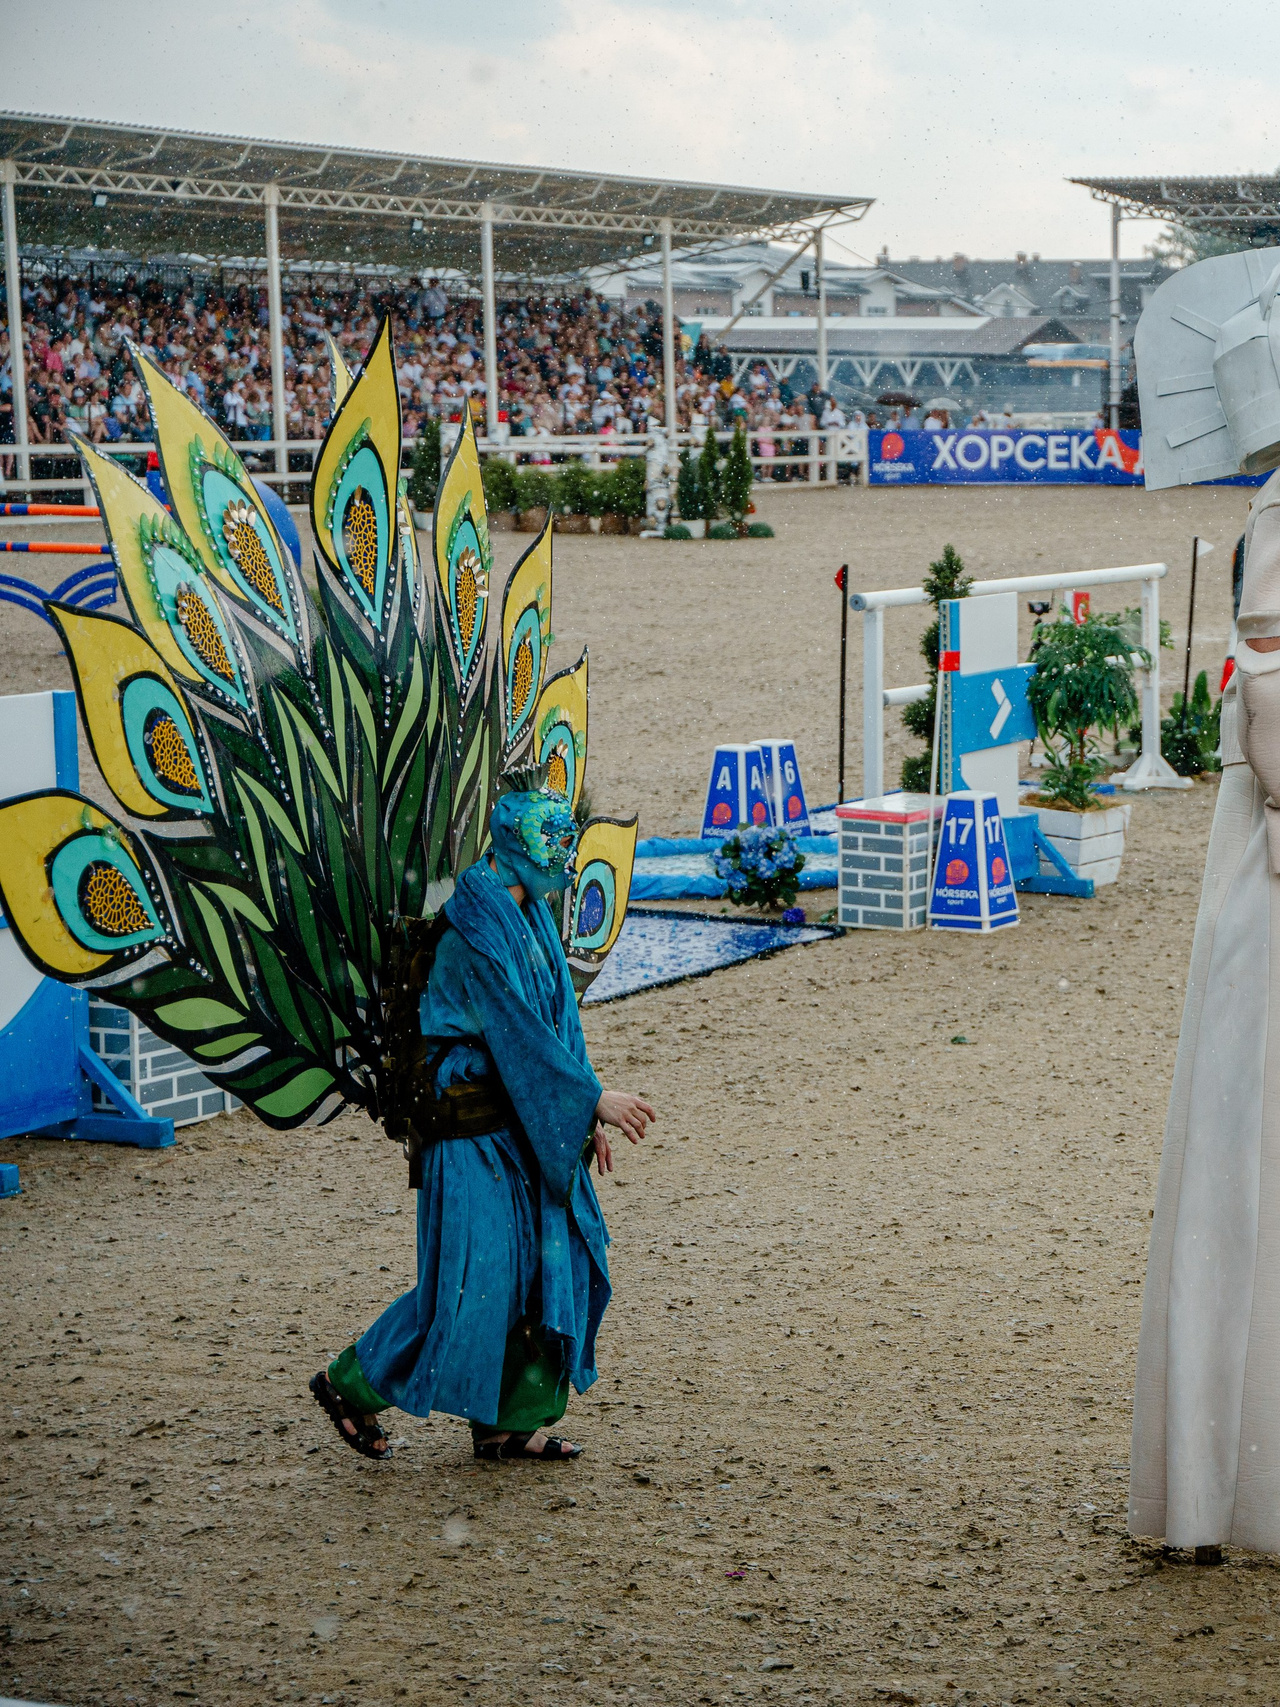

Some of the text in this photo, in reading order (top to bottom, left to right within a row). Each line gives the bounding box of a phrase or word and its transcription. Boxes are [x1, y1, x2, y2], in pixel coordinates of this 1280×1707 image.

[932, 434, 1125, 470] ХОРСЕКА
[716, 766, 732, 791] A
[751, 766, 762, 790] A
[784, 760, 796, 785] 6
[946, 817, 974, 845] 17
[984, 815, 1000, 844] 17
